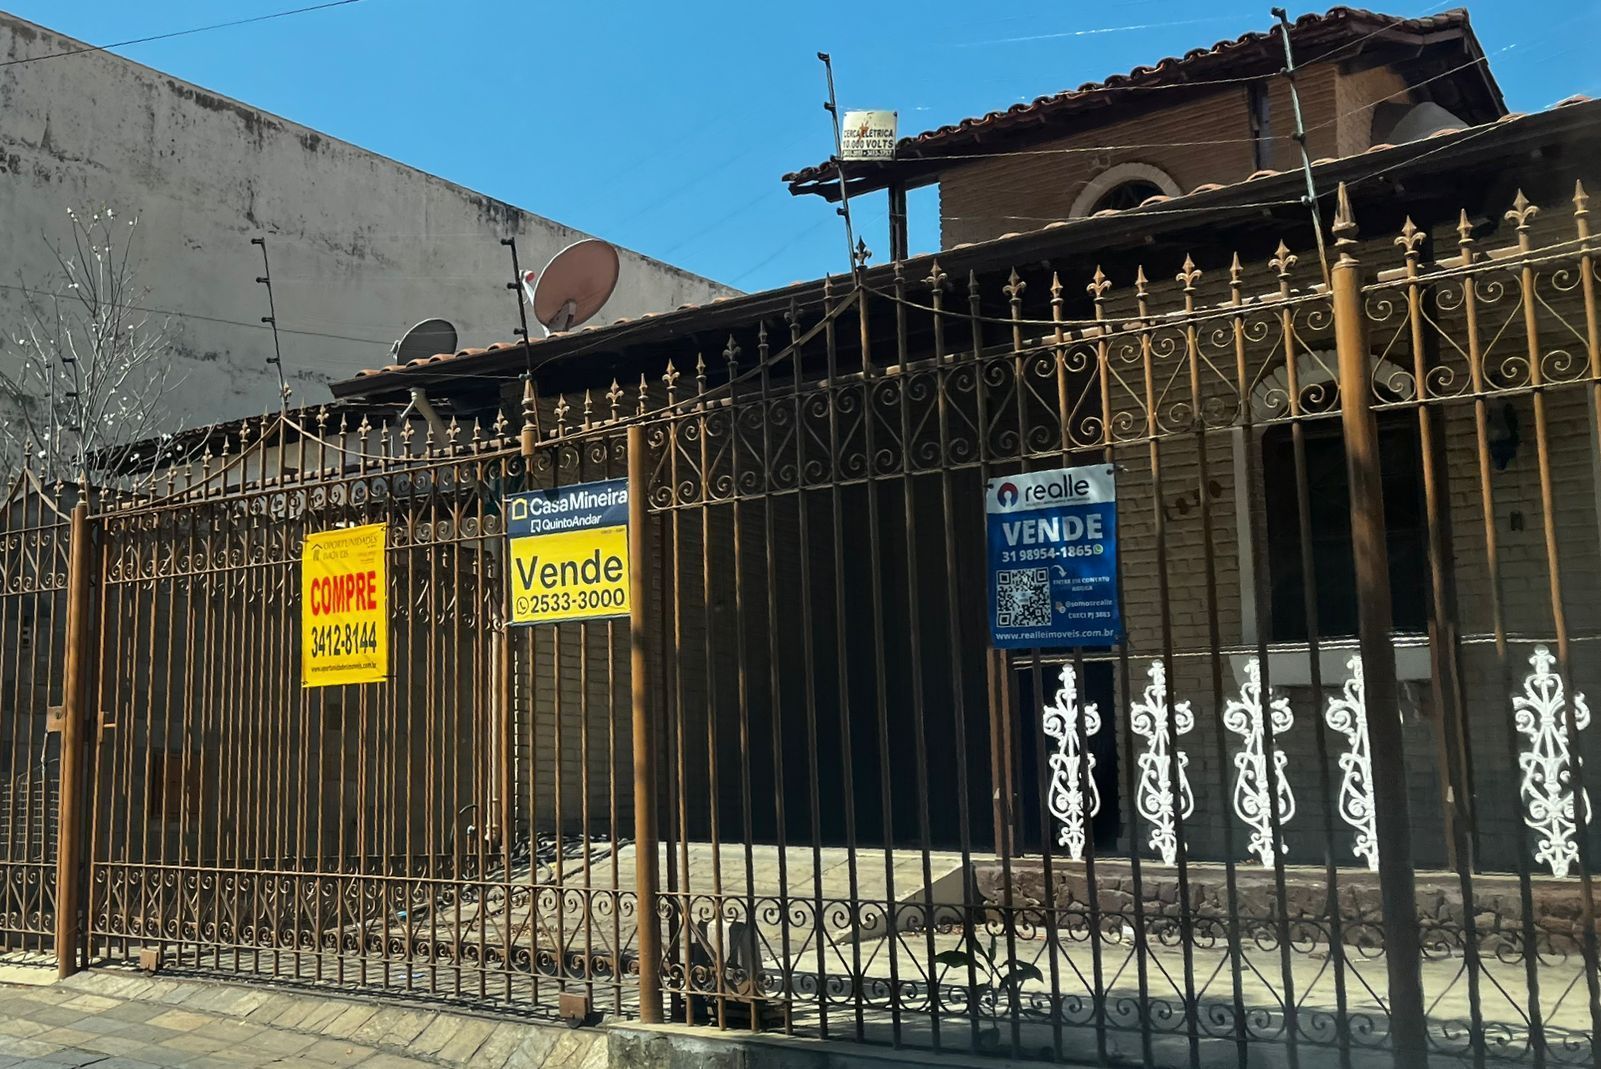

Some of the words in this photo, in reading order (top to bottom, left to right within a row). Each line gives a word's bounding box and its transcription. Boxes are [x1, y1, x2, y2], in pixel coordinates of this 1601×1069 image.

[866, 140, 893, 149] VOLTS
[1025, 474, 1090, 502] realle
[542, 513, 602, 531] QuintoAndar
[1002, 513, 1103, 547] VENDE
[1002, 550, 1017, 563] 31
[1019, 544, 1093, 561] 98954-1865
[515, 548, 624, 591] Vende
[310, 570, 377, 617] COMPRE
[530, 588, 625, 614] 2533-3000
[311, 620, 377, 658] 3412-8144
[995, 628, 1114, 640] www.realleimoveis.com.br
